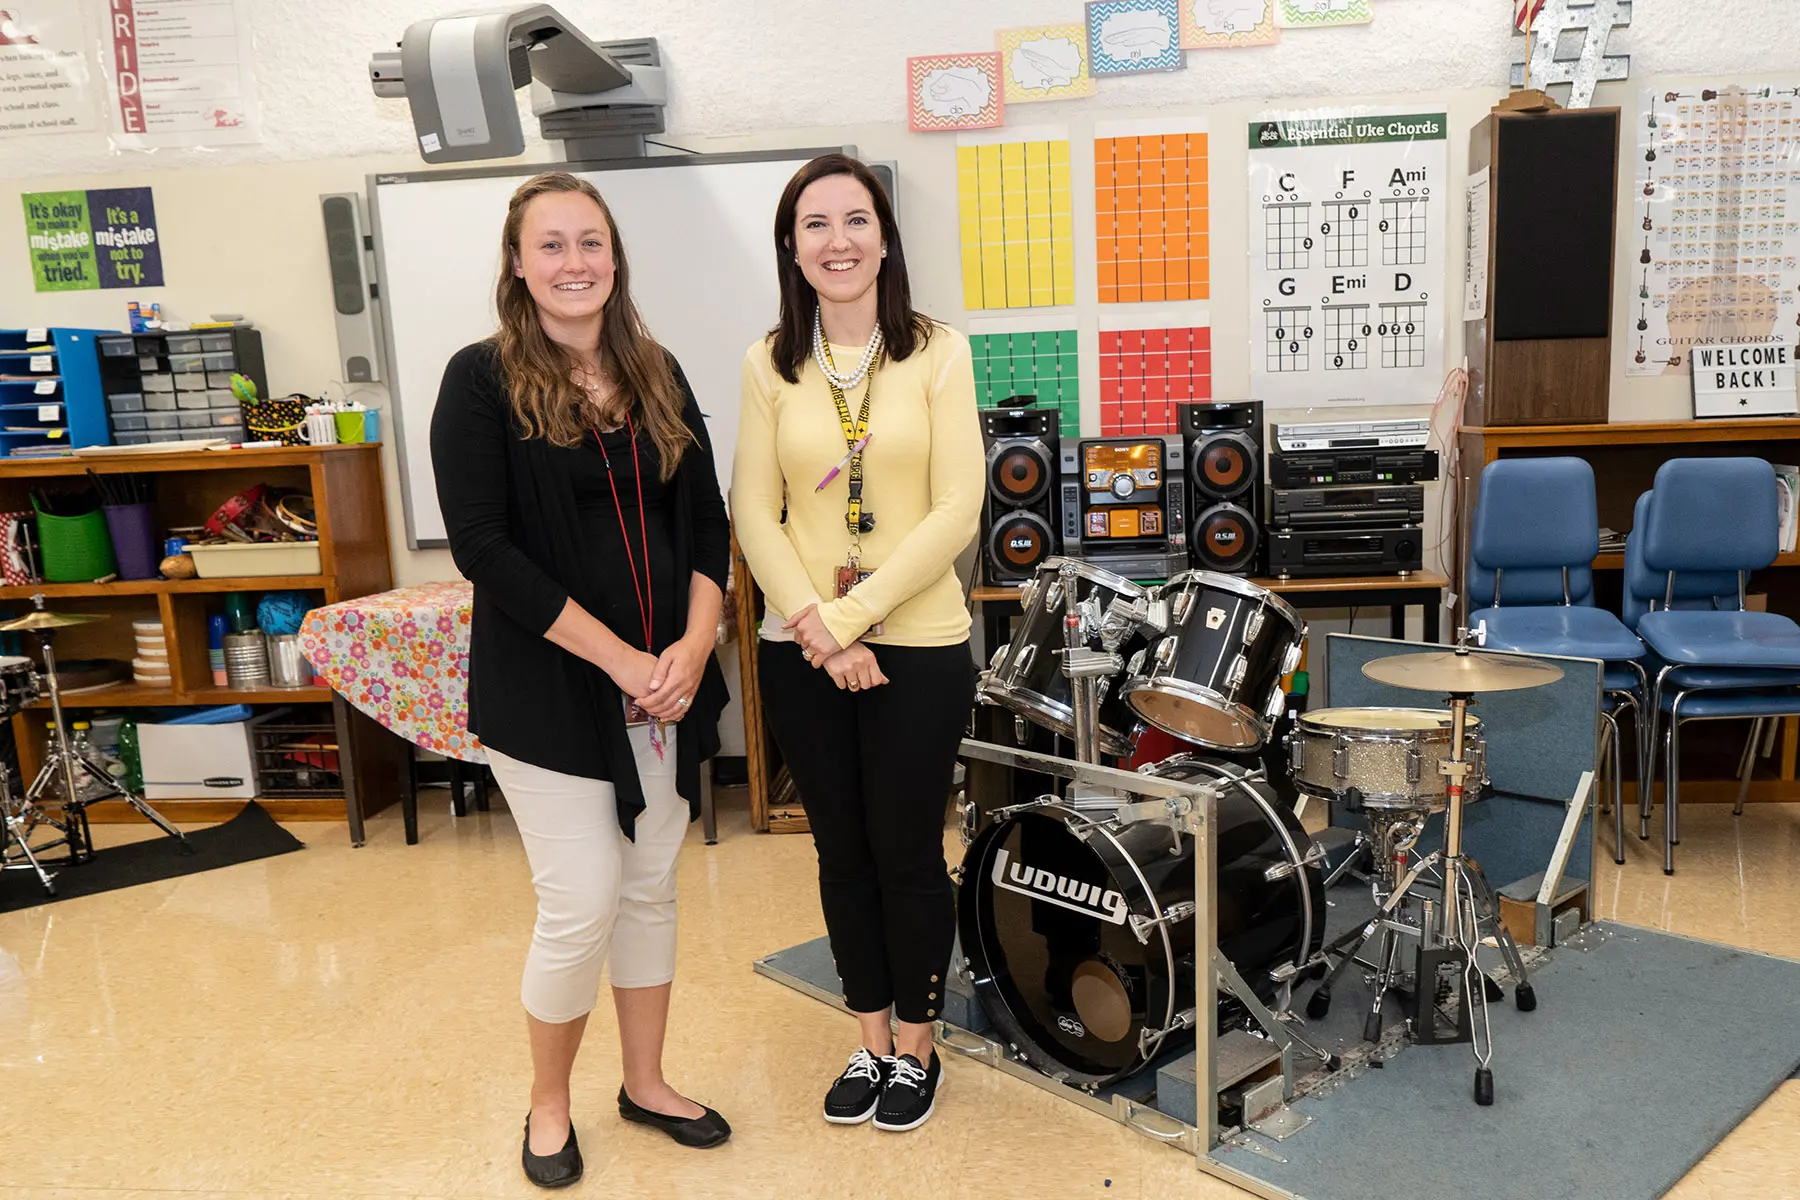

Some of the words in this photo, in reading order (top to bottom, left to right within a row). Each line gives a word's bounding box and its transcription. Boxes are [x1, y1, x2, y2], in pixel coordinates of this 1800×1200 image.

[112, 0, 141, 131] RIDE
[1287, 124, 1353, 141] Essential
[1356, 123, 1385, 138] Uke
[1388, 120, 1440, 136] Chords
[1279, 173, 1295, 192] C
[1342, 170, 1355, 189] F
[29, 203, 49, 219] It's
[52, 202, 82, 221] okay
[106, 207, 127, 225] It's
[130, 210, 139, 224] a
[30, 230, 89, 251] mistake
[96, 226, 155, 248] mistake
[110, 248, 129, 260] not
[131, 247, 144, 259] to
[44, 261, 88, 282] tried.
[116, 261, 145, 285] try.
[1278, 277, 1296, 296] G
[1395, 273, 1412, 291] D
[1656, 337, 1715, 346] GUITAR
[1720, 335, 1784, 344] CHORDS
[1701, 348, 1786, 366] WELCOME
